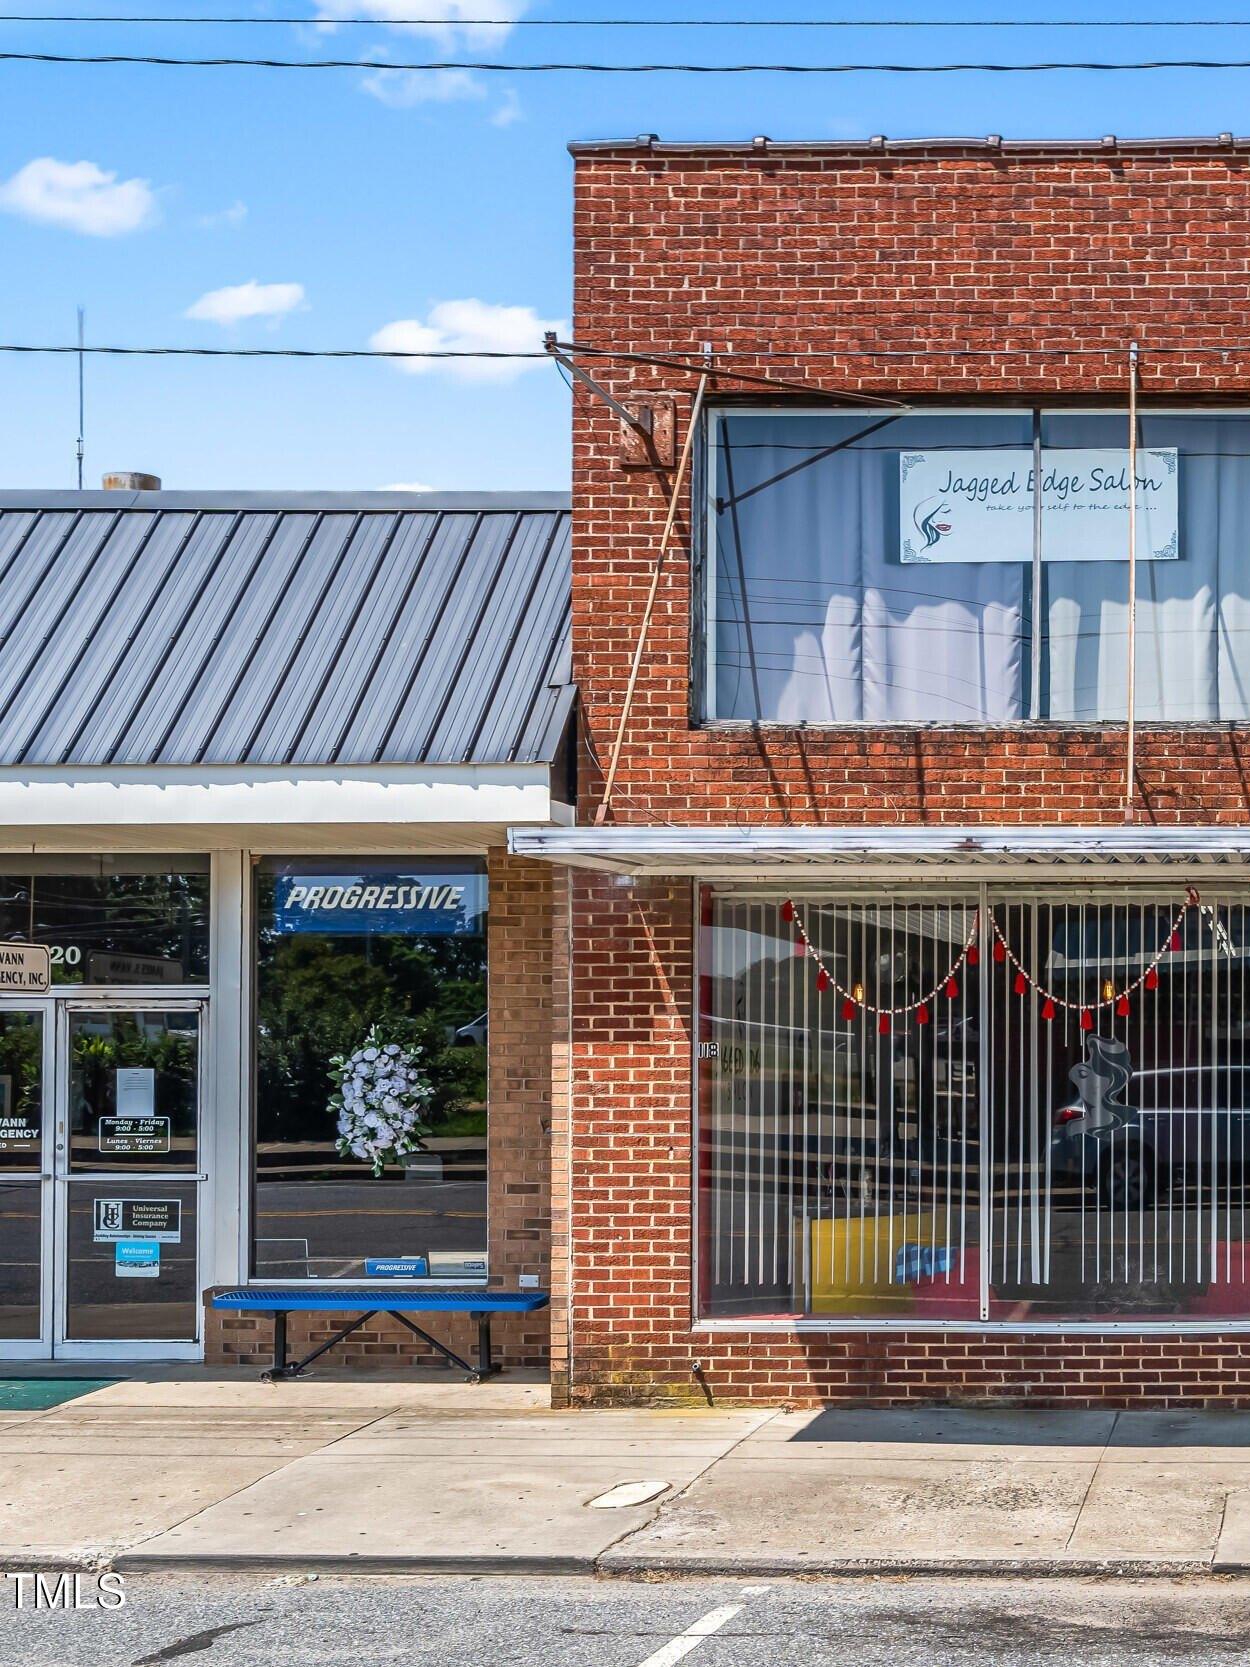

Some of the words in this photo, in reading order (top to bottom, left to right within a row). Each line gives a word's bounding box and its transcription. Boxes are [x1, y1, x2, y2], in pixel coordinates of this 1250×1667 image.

[939, 470, 1020, 501] Jagged
[1027, 468, 1084, 500] Edge
[284, 886, 465, 909] PROGRESSIVE
[29, 972, 47, 985] INC.
[698, 1042, 719, 1058] 118
[132, 1220, 168, 1228] Company
